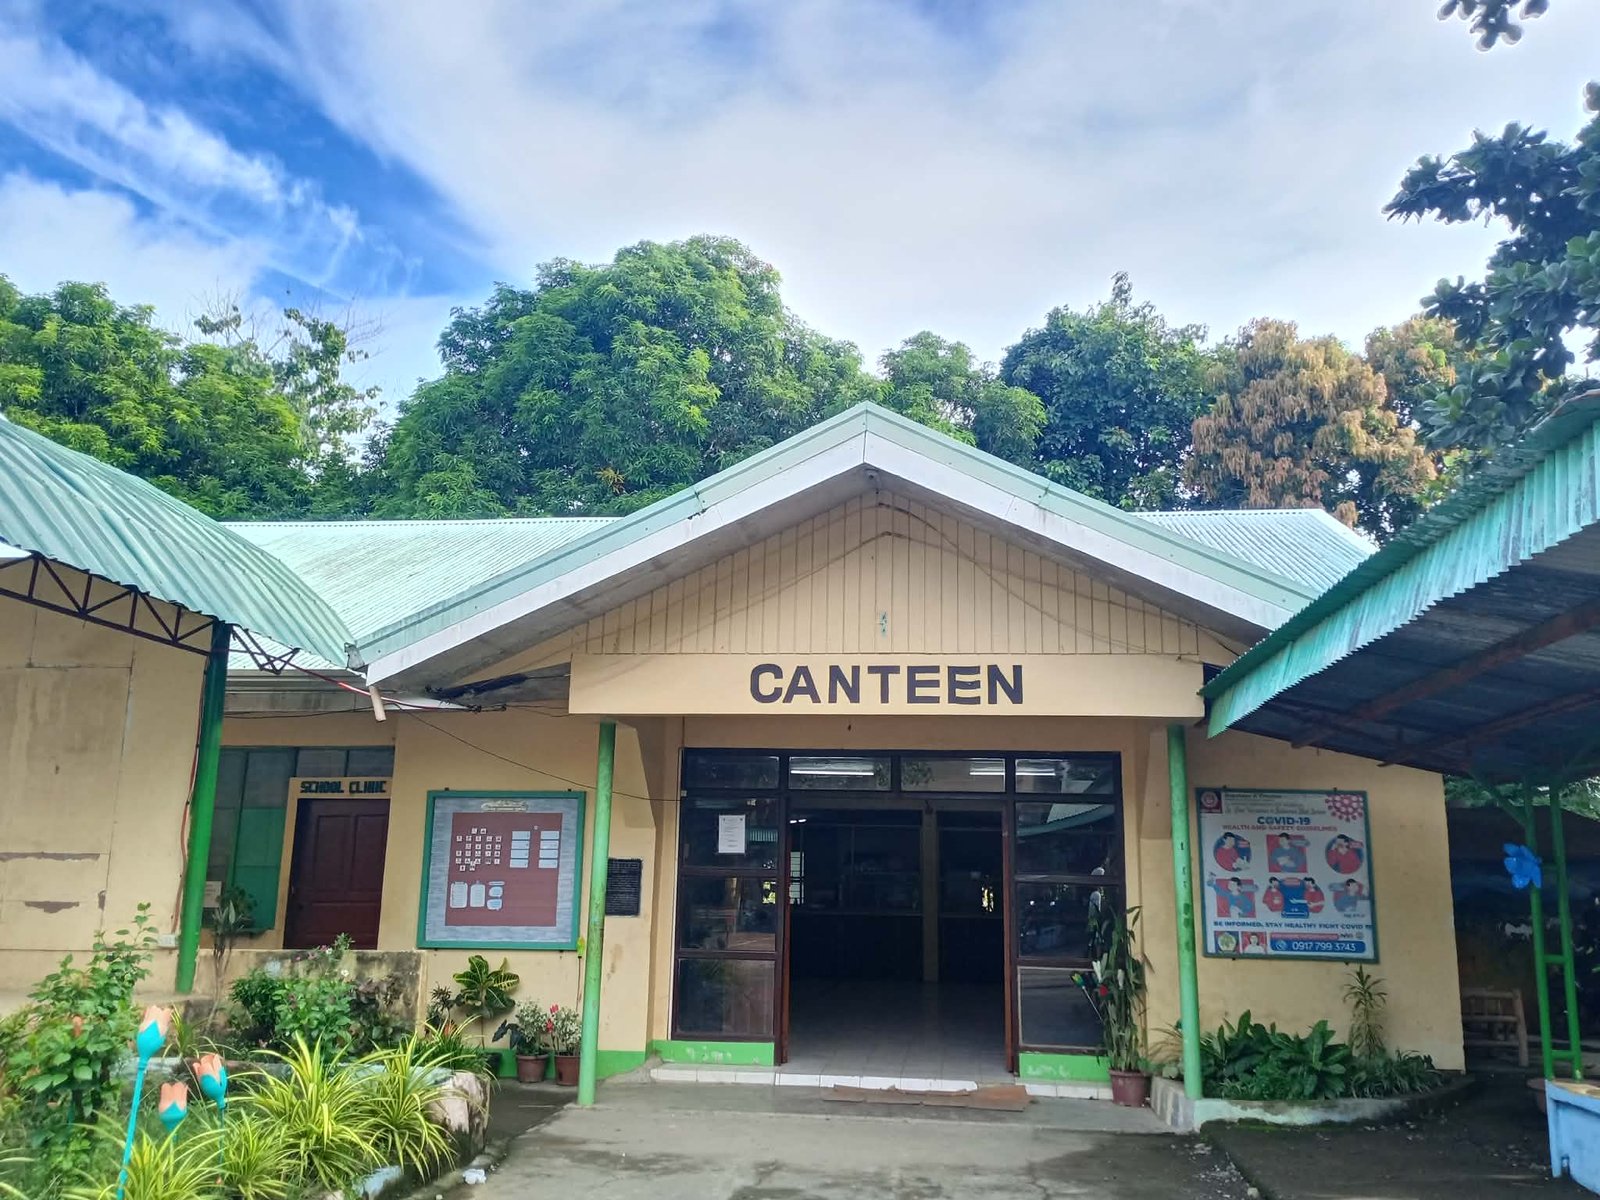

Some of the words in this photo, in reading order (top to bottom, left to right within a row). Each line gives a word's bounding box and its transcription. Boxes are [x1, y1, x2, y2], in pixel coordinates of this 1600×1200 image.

[750, 663, 1023, 704] CANTEEN
[300, 780, 344, 793] SCHOOL
[348, 780, 387, 793] CLINIC
[1256, 816, 1311, 825] COVID-19
[1268, 824, 1294, 832] SAFETY
[1318, 922, 1339, 930] FIGHT
[1340, 922, 1363, 930] COVID
[1291, 941, 1314, 951] 0917
[1314, 941, 1333, 952] 799
